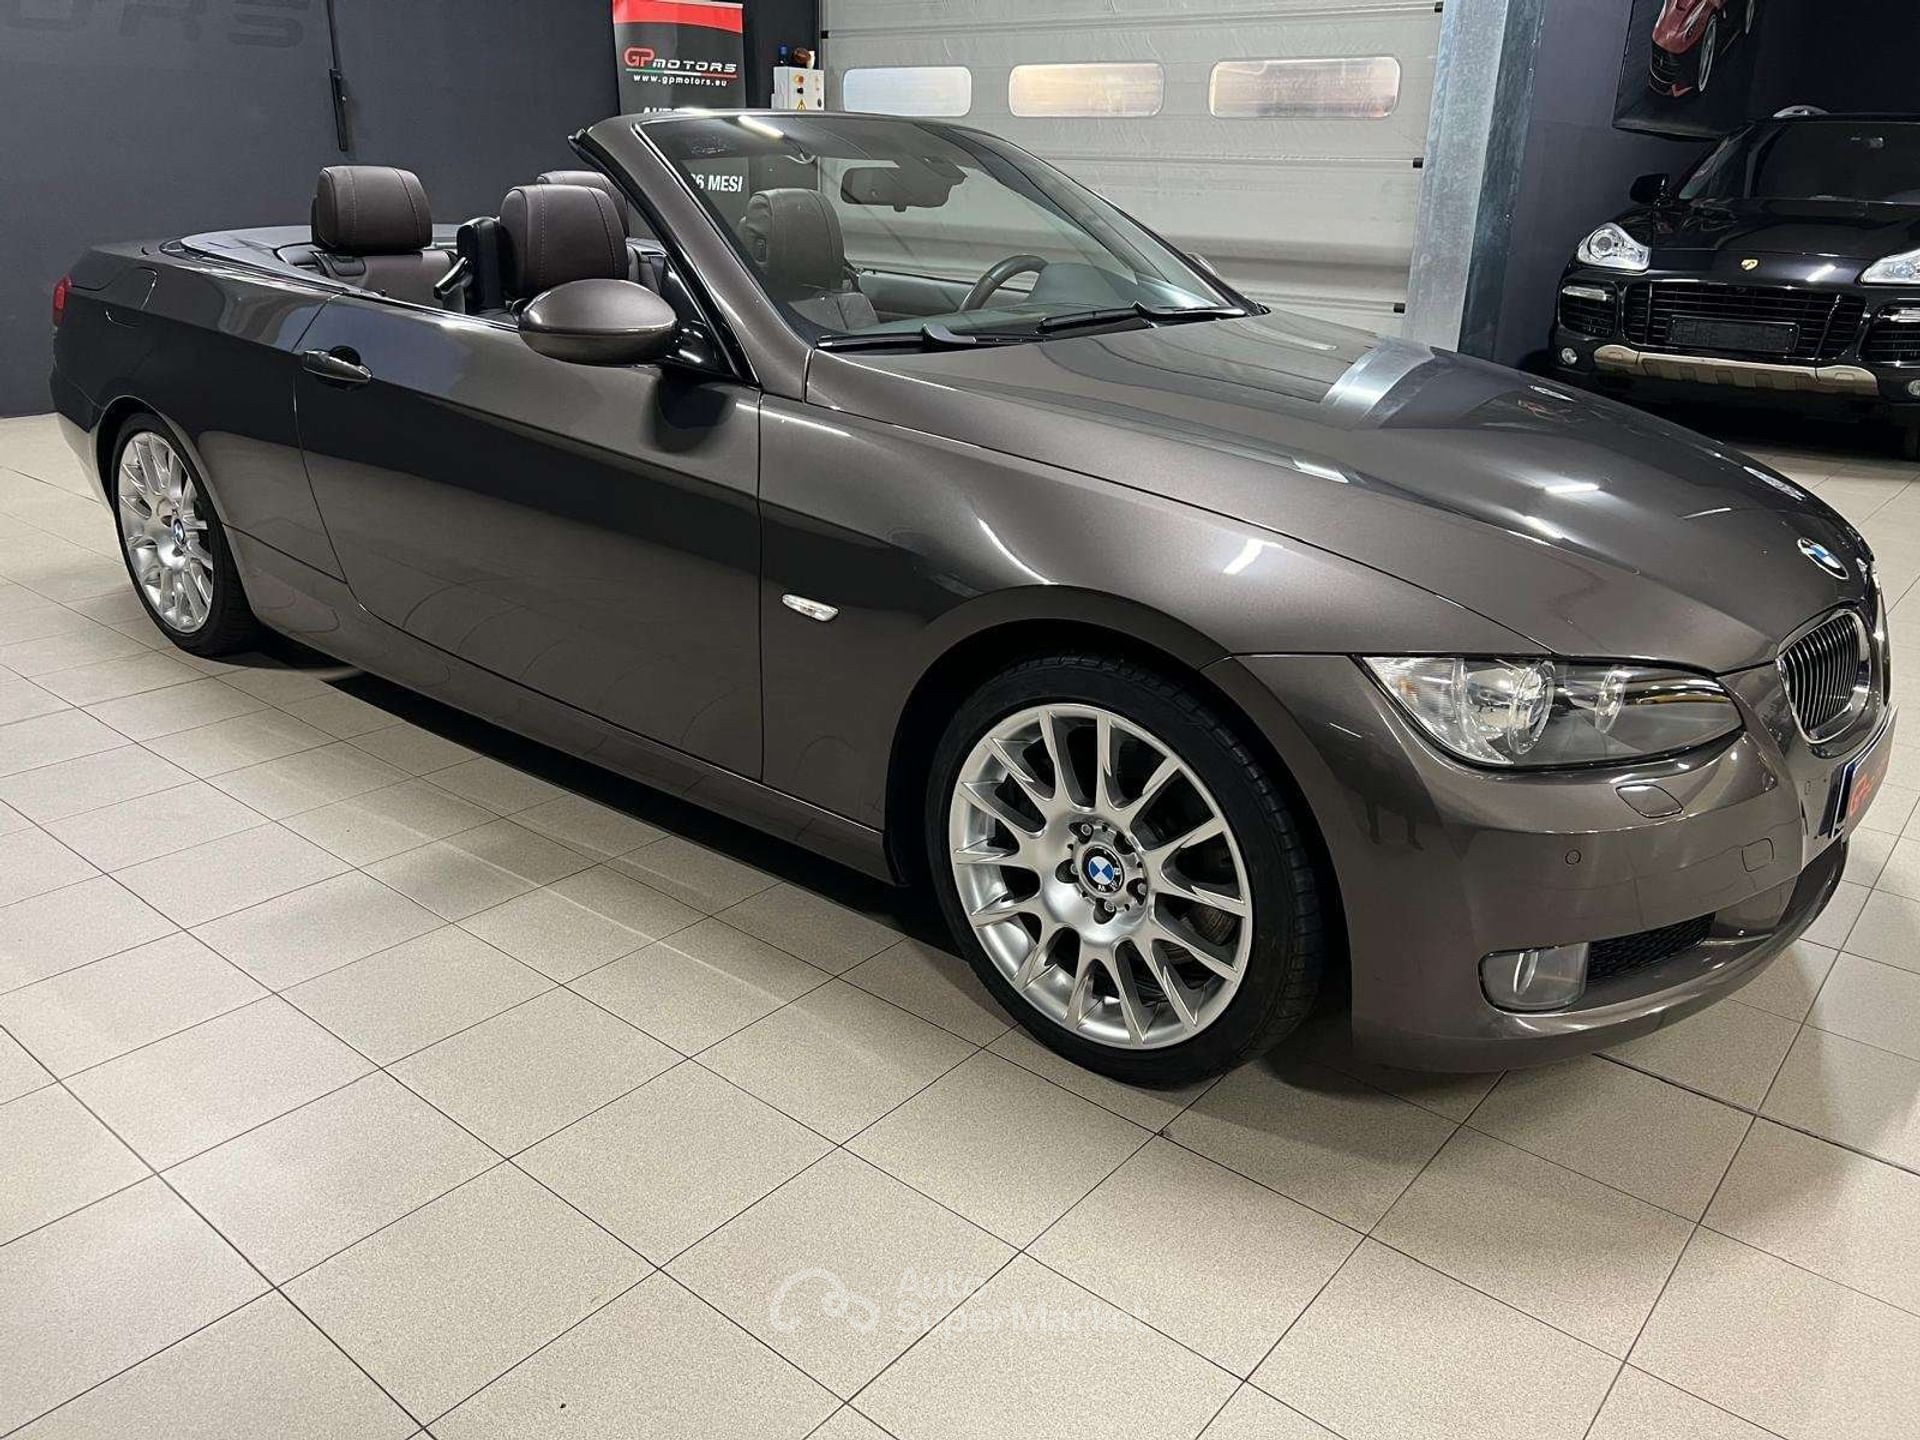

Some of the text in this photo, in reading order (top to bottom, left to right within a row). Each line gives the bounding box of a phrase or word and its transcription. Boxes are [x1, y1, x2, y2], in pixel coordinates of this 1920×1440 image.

[633, 75, 727, 87] www.gpmotors.eu
[691, 173, 743, 192] 6 MESI
